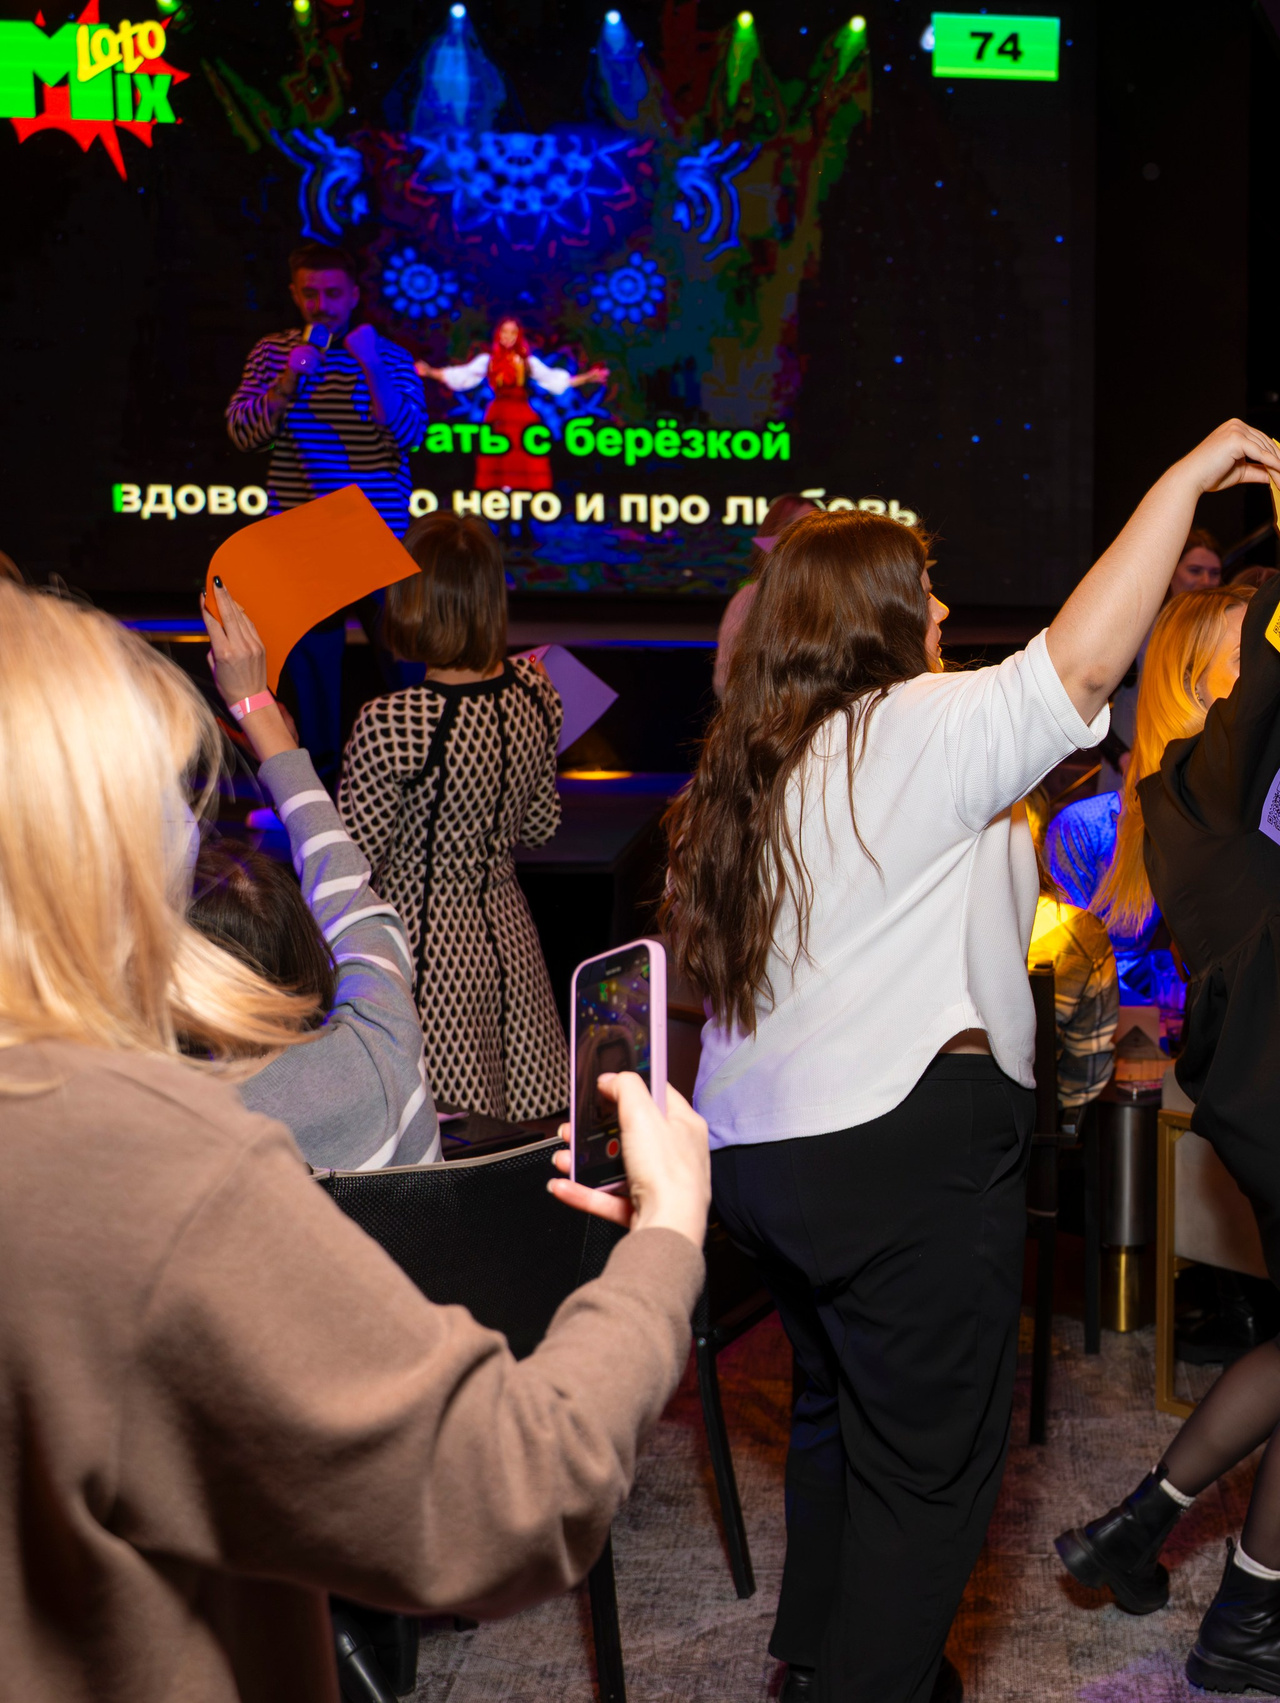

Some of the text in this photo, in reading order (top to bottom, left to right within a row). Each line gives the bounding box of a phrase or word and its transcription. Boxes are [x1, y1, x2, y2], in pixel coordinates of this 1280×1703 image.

[970, 31, 1023, 62] 74
[412, 417, 791, 467] ать с берёзкой
[112, 483, 269, 520] вдово
[452, 489, 562, 523] него
[575, 493, 605, 523] и
[620, 493, 711, 533] про
